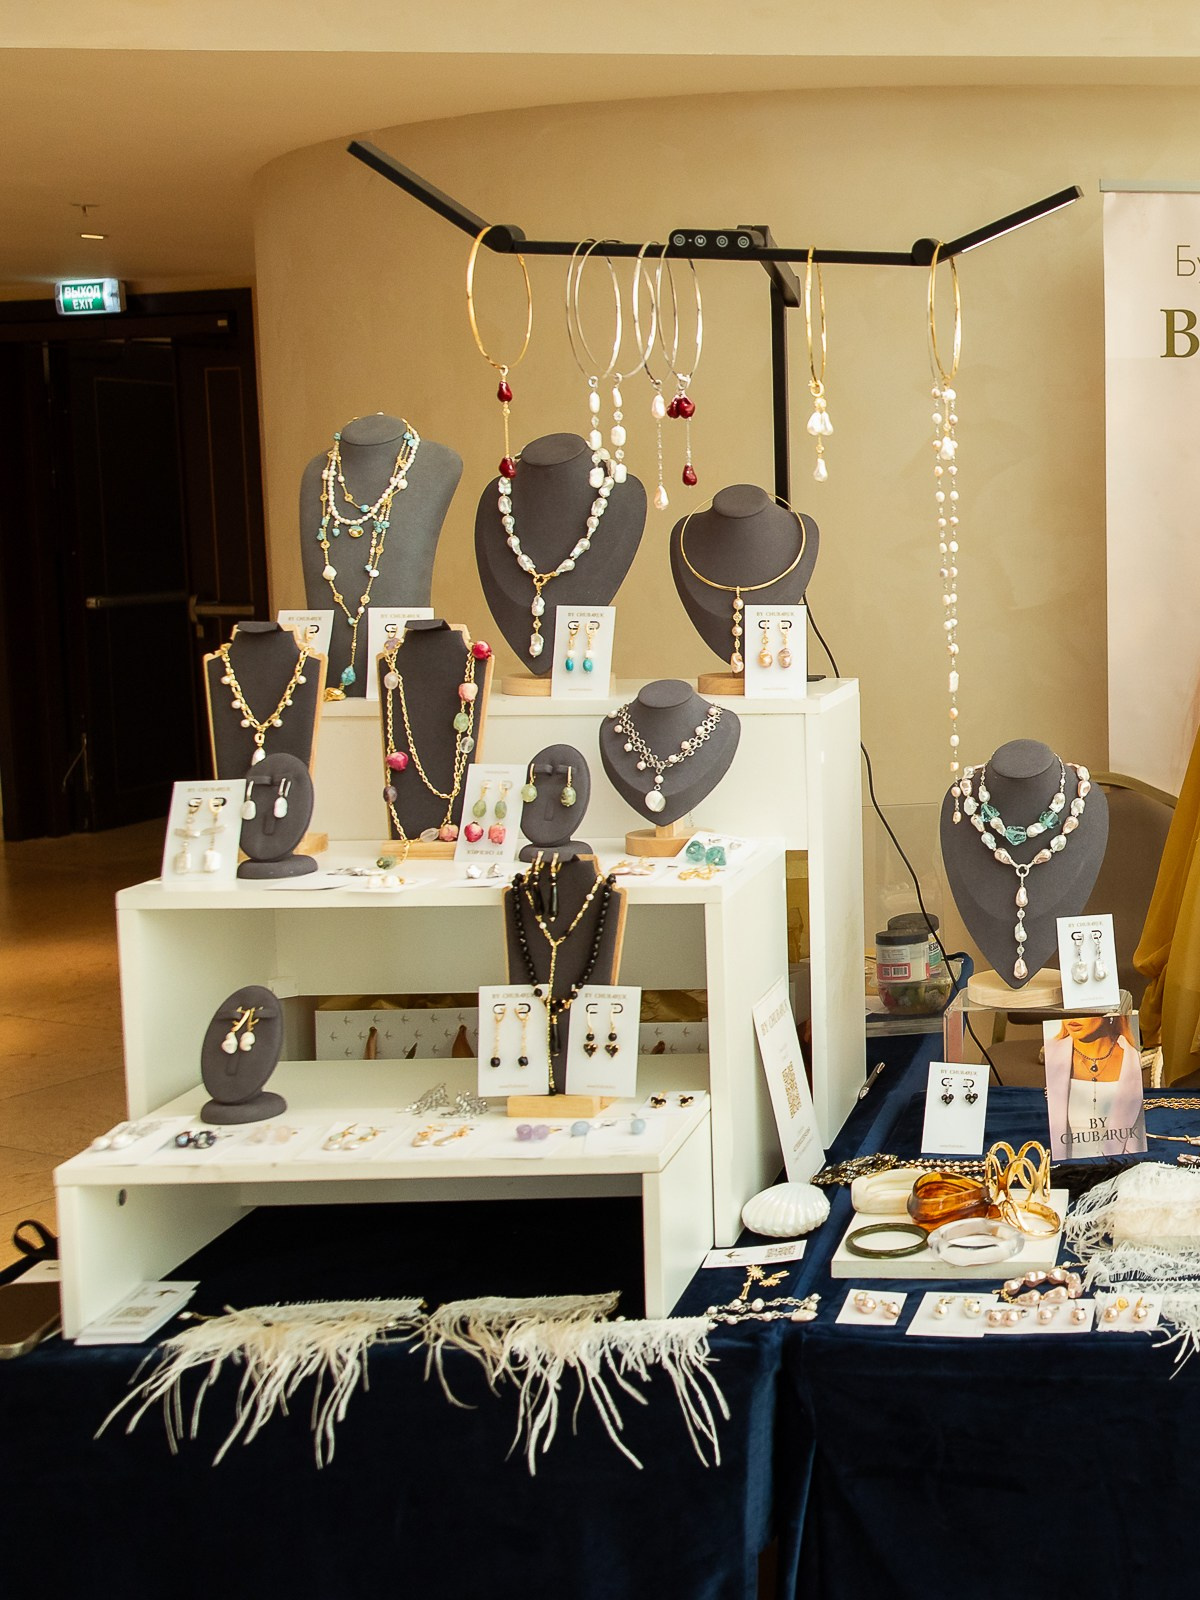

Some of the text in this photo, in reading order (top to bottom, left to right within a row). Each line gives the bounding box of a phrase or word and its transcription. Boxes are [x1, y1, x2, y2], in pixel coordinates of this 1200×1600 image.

[64, 285, 101, 299] ВЫХОД
[72, 298, 94, 310] EXIT
[1089, 1117, 1107, 1129] BY
[1060, 1127, 1140, 1145] CHUBARUK
